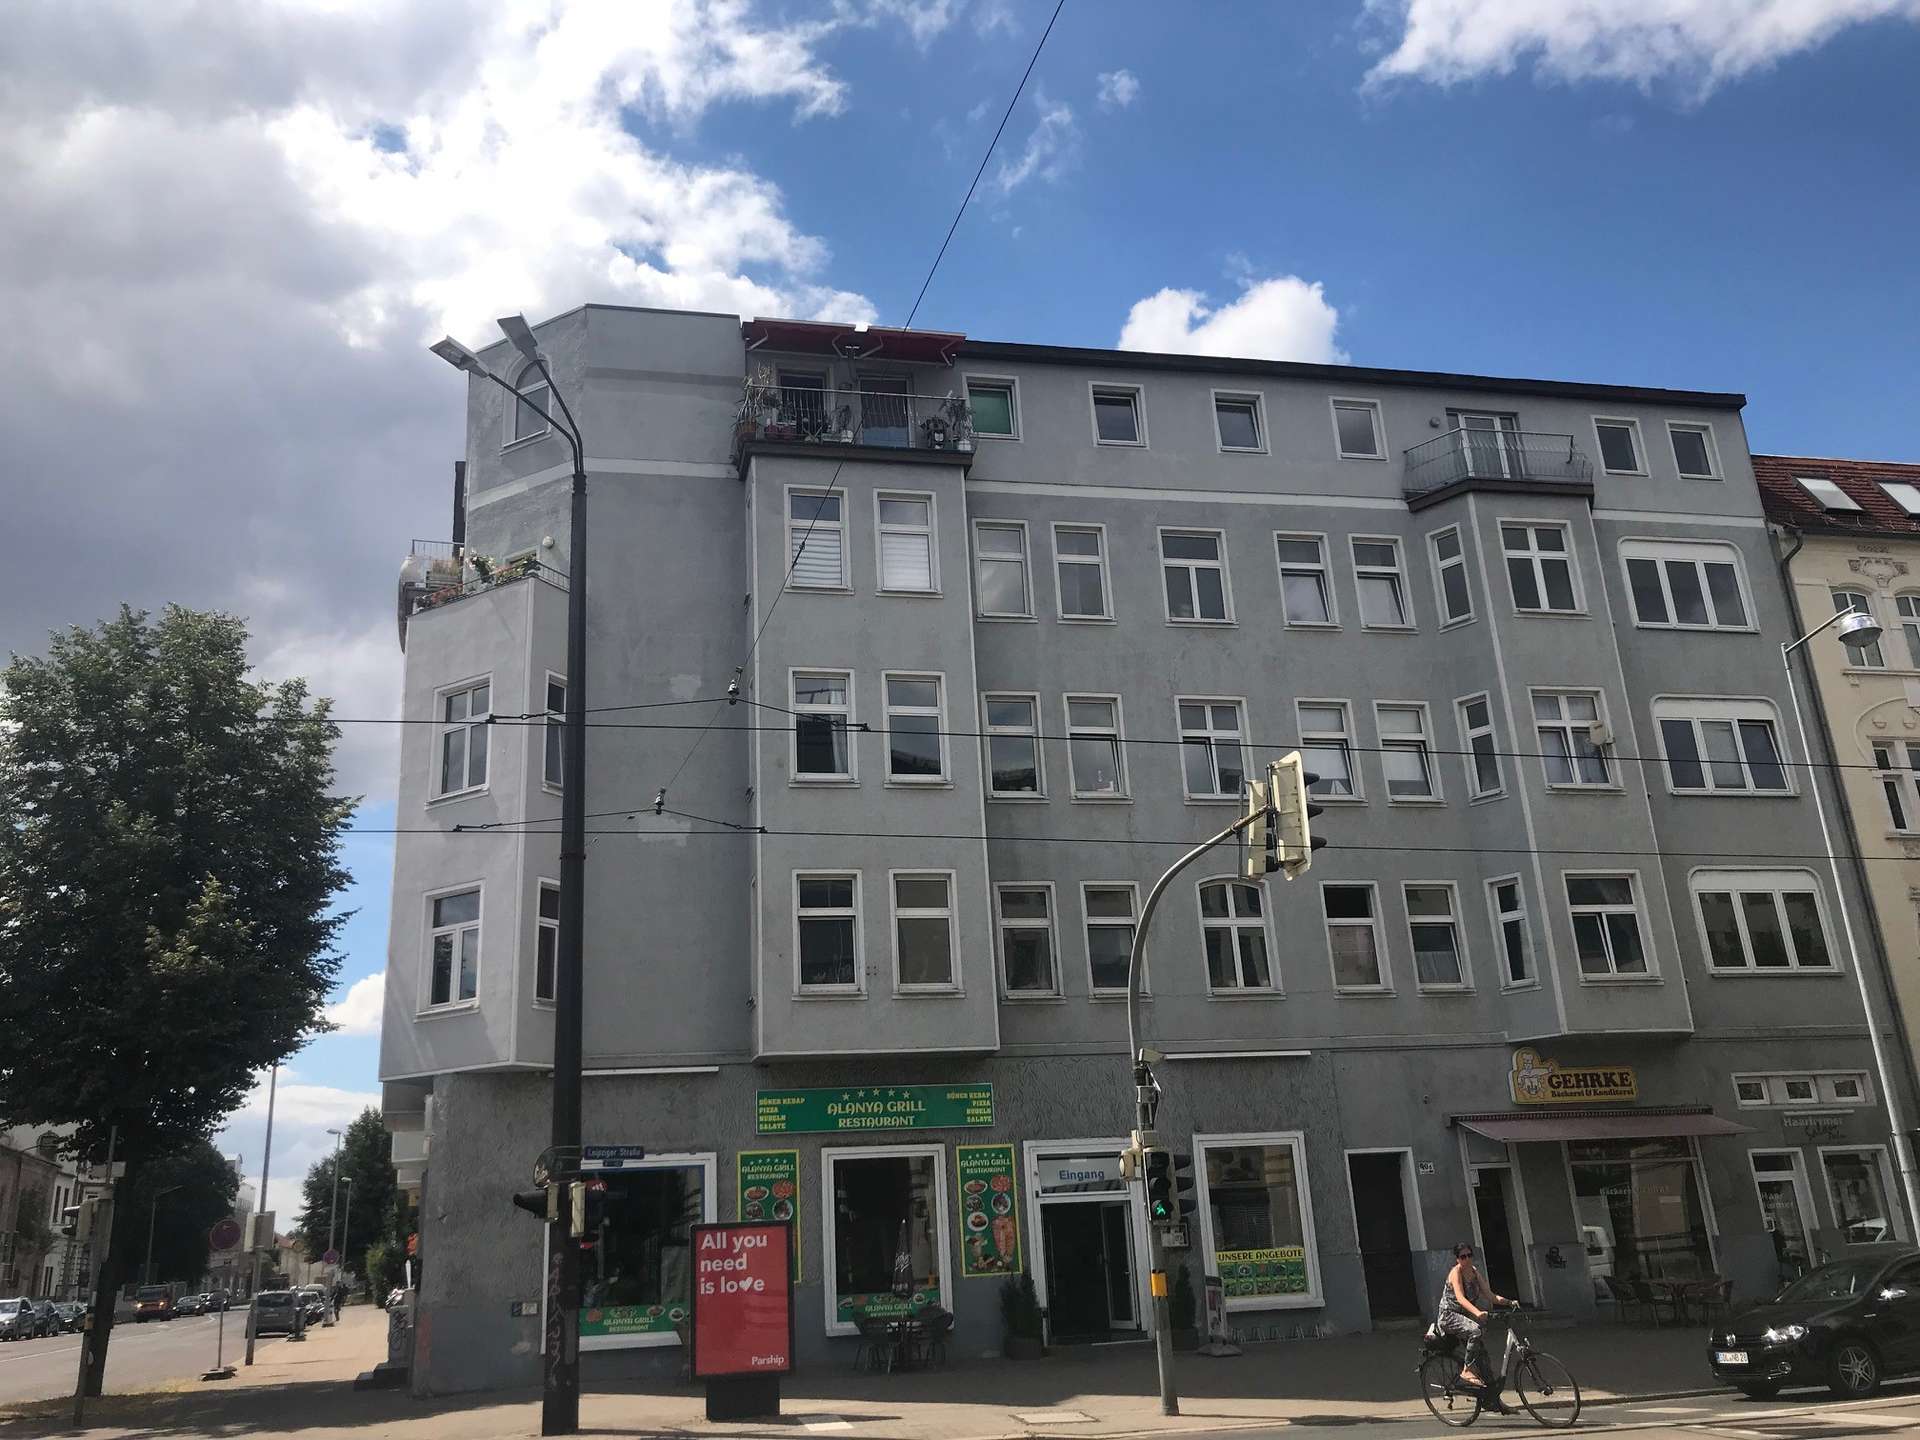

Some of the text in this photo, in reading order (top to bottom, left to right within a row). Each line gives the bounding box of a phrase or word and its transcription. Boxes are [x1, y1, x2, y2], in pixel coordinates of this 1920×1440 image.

[1548, 1071, 1632, 1089] GEHRKE
[828, 1100, 926, 1115] ALANYA GRILL
[839, 1116, 915, 1128] RESTAURANT
[742, 1164, 772, 1173] ALANYA
[961, 1158, 1010, 1168] ALANYA GRILL
[1059, 1170, 1104, 1181] Eingang
[701, 1232, 768, 1253] All you
[1218, 1249, 1303, 1261] UNSERE ANGEBOTE
[701, 1253, 747, 1272] need
[701, 1278, 714, 1295] is
[751, 1355, 784, 1366] Parship
